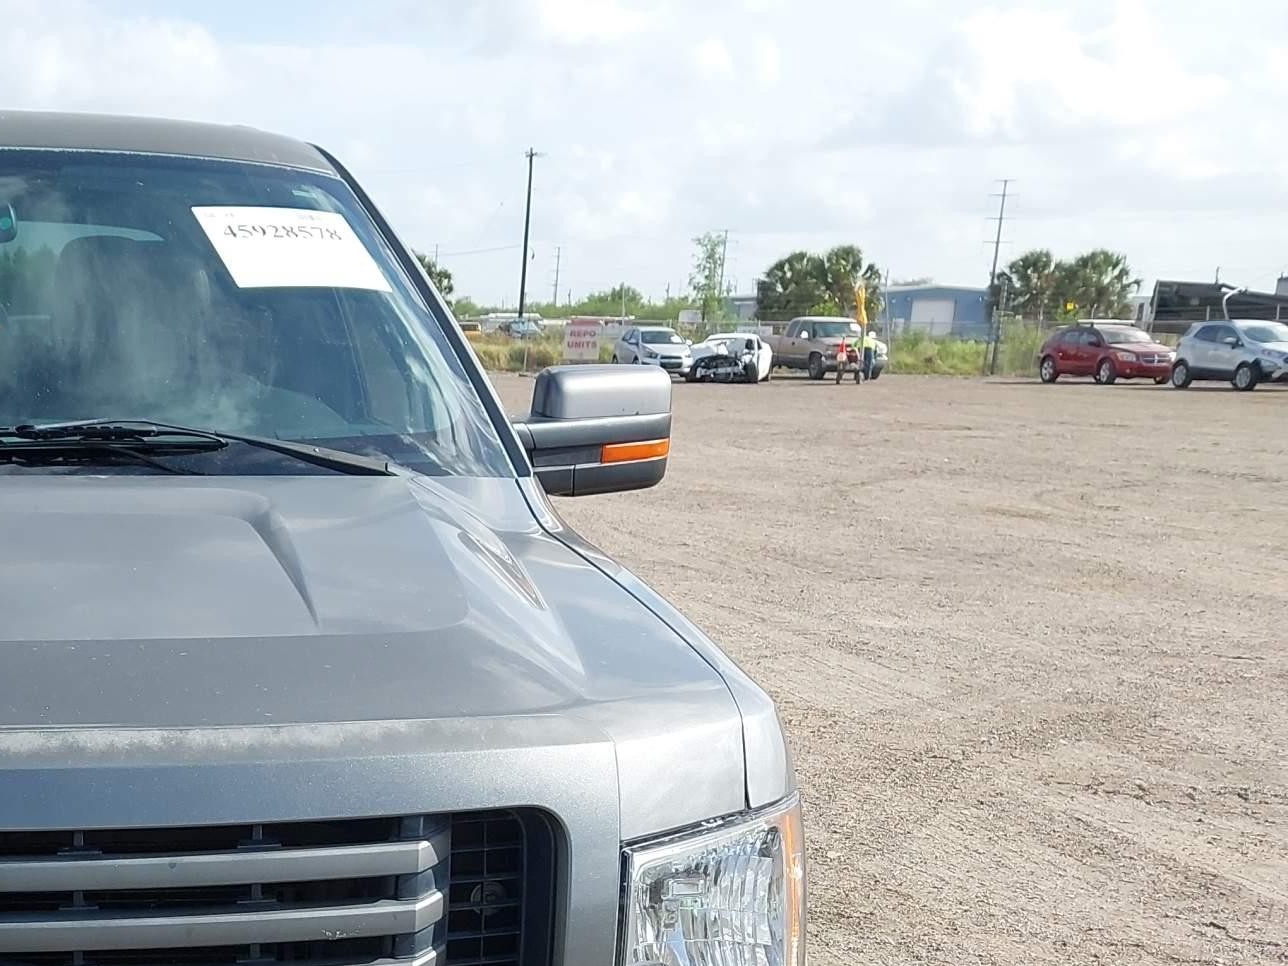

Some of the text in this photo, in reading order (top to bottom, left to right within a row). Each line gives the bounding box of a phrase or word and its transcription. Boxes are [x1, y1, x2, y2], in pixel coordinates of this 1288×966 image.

[223, 224, 343, 241] 45928578
[569, 329, 597, 338] REPO
[567, 340, 598, 349] UNITS
